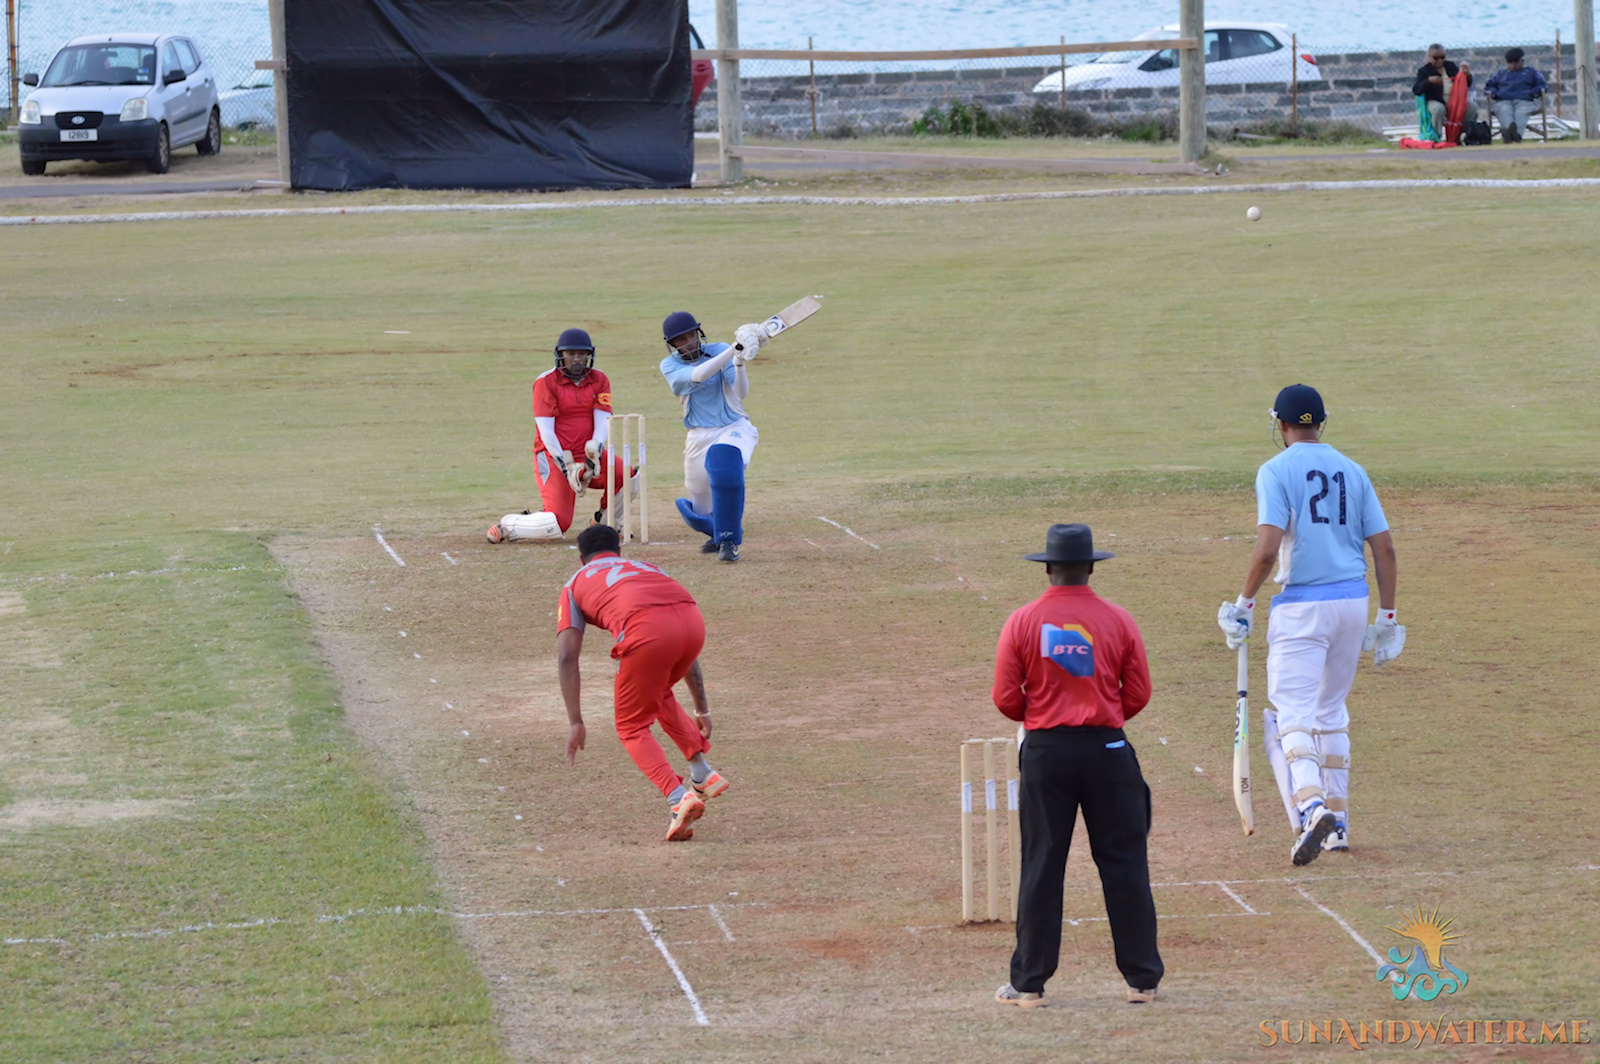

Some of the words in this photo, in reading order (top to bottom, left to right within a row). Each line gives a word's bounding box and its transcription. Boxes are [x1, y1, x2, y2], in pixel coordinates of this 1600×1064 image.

[1306, 469, 1346, 525] 21
[1052, 645, 1089, 655] BTC
[1241, 777, 1249, 794] TON
